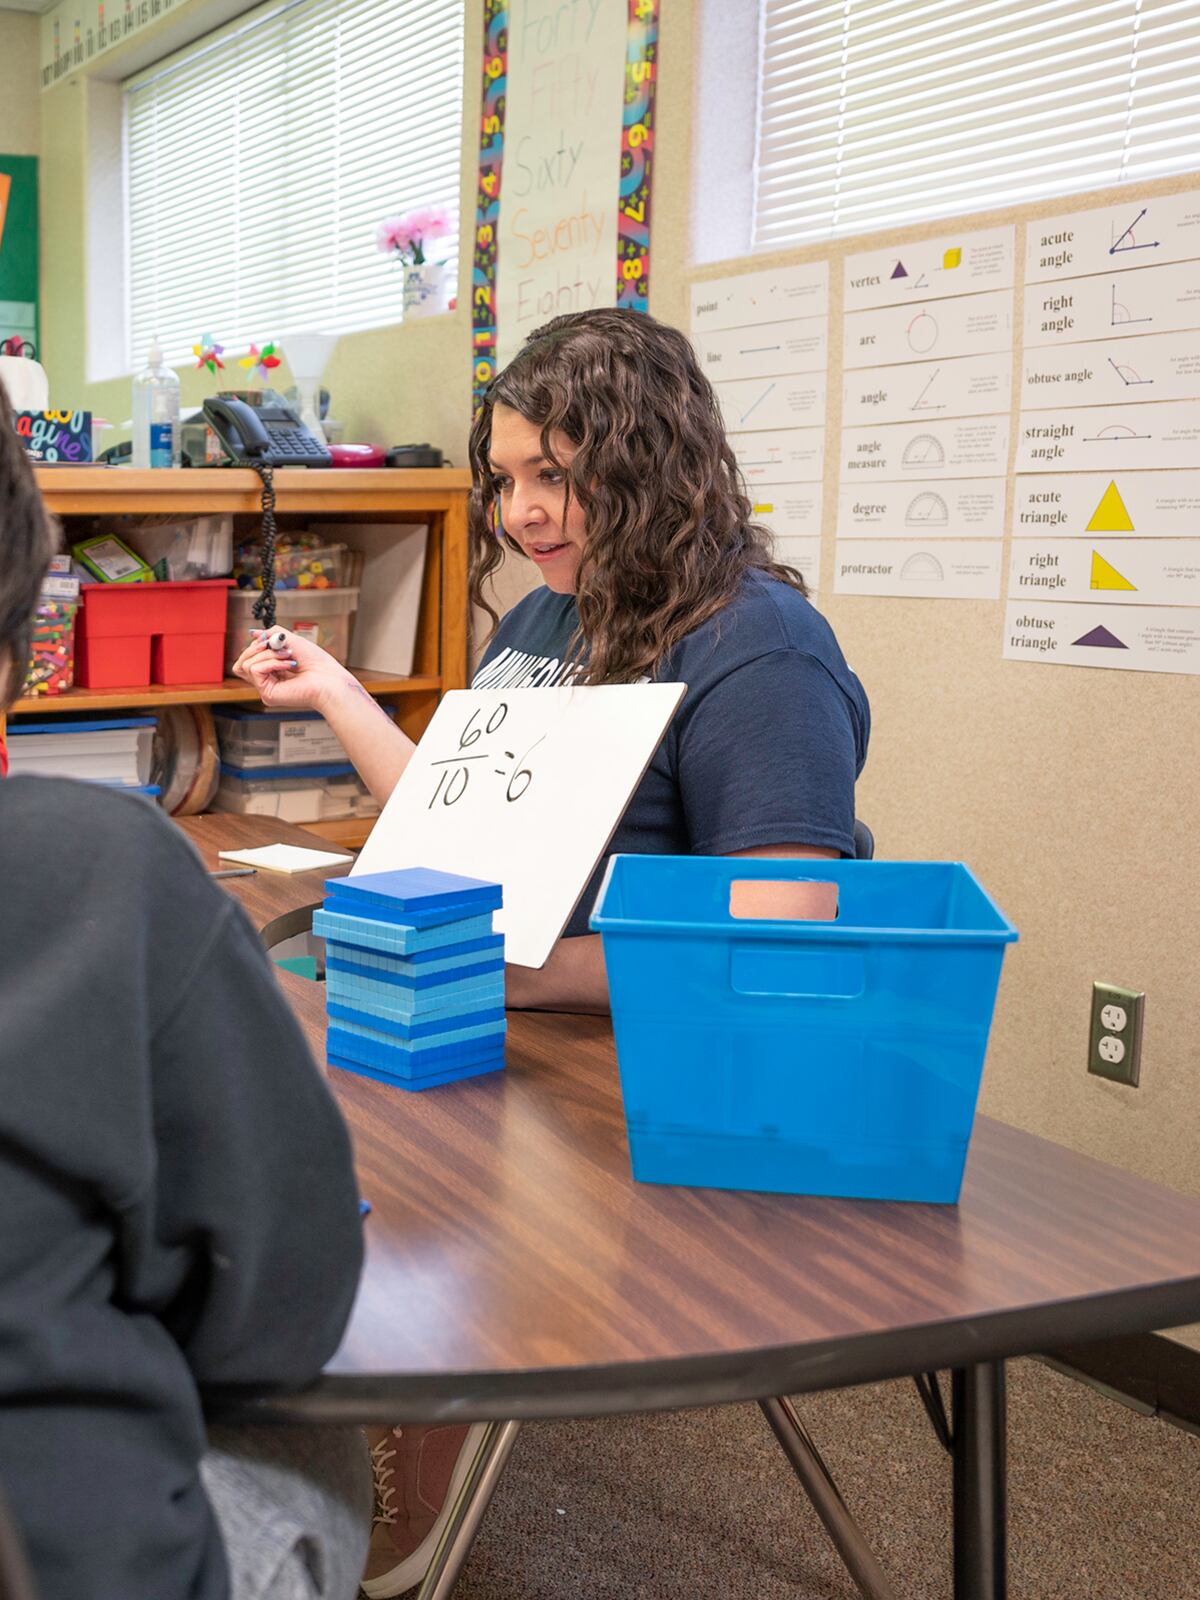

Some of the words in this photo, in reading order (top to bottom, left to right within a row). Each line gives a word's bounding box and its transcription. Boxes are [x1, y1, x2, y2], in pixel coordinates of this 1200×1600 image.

[512, 129, 584, 198] Sixty
[511, 190, 605, 268] Seventy
[1040, 231, 1074, 246] acute
[1039, 251, 1074, 268] angle
[623, 258, 642, 280] 8
[850, 275, 881, 288] vertex
[696, 301, 718, 317] point
[1043, 295, 1073, 313] right
[1041, 316, 1074, 333] angle
[859, 335, 876, 346] arc
[707, 351, 723, 363] line
[1027, 373, 1062, 385] obtuse
[1064, 368, 1093, 383] angle
[860, 391, 887, 406] angle
[16, 416, 81, 460] agine
[1025, 424, 1074, 440] straight
[856, 440, 882, 454] angle
[1031, 445, 1065, 461] angle
[847, 459, 887, 469] measure
[1028, 491, 1061, 503] acute
[852, 502, 887, 516] degree
[1020, 510, 1068, 526] triangle
[1029, 553, 1059, 568] right
[840, 562, 893, 576] protractor
[1019, 573, 1067, 589] triangle
[1016, 615, 1055, 629] obtuse
[1010, 636, 1058, 651] triangle
[458, 703, 508, 752] 60
[506, 733, 547, 803] 6
[428, 767, 469, 809] 10
